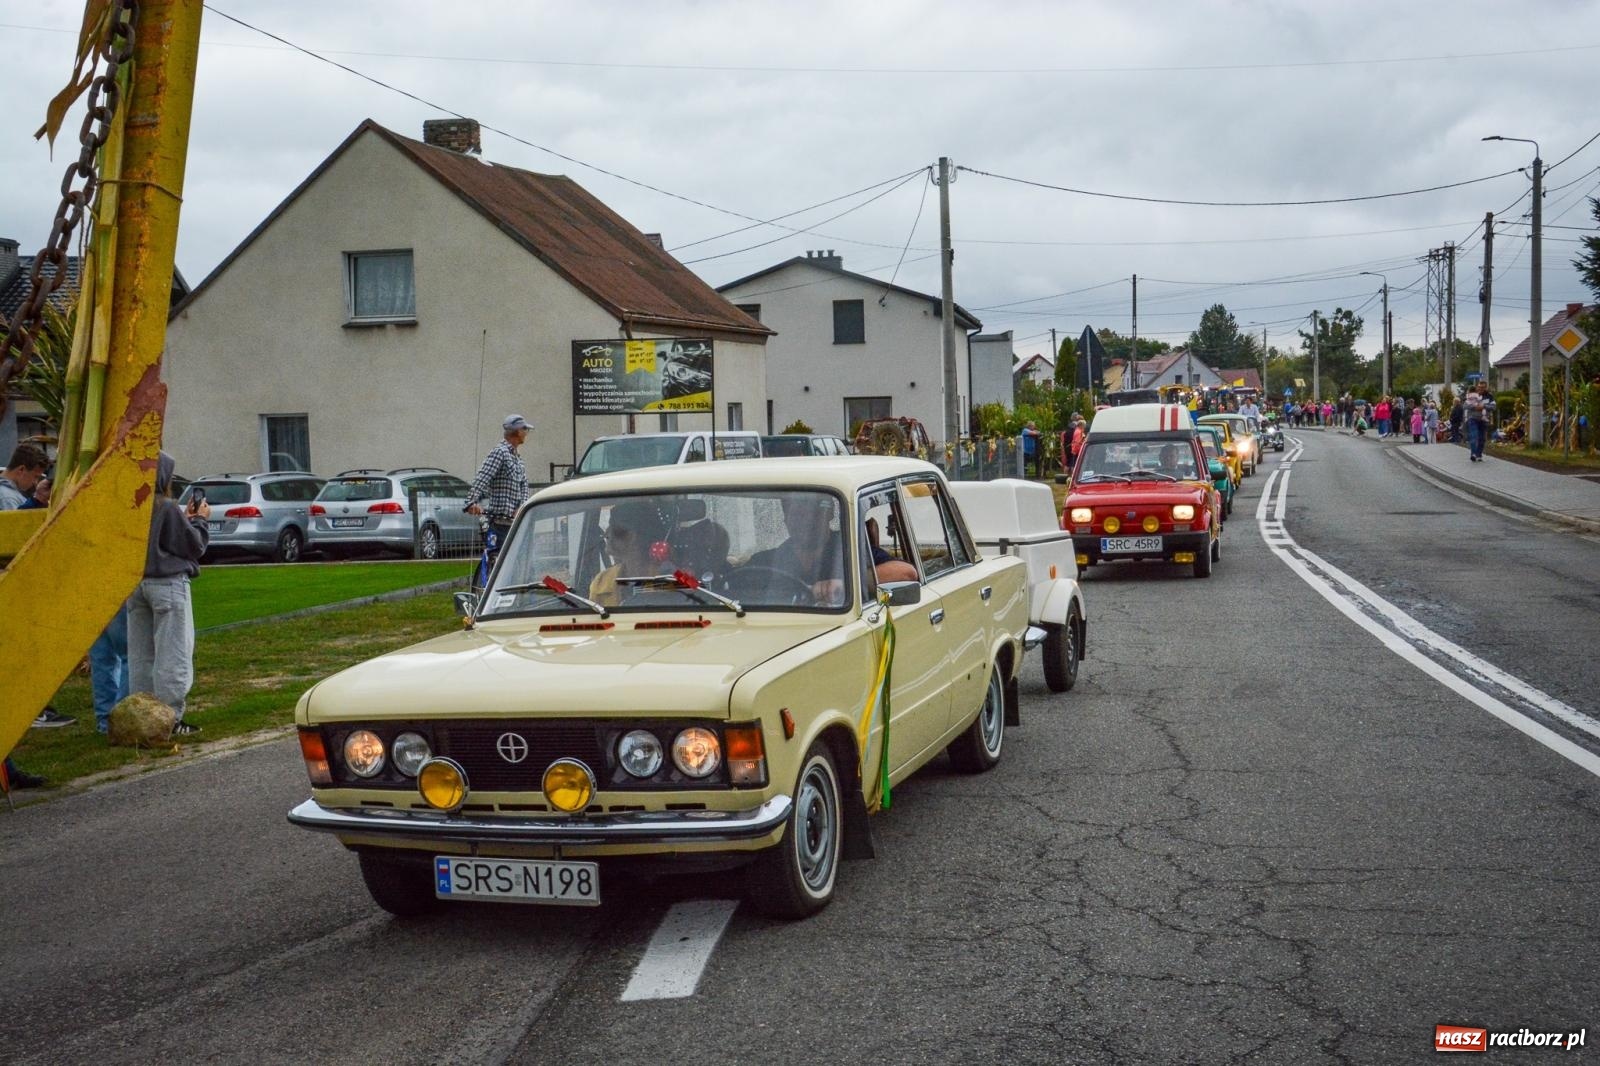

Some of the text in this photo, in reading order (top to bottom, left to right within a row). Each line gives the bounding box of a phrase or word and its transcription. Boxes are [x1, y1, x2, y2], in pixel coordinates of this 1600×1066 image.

[582, 358, 613, 368] AUTO
[1108, 539, 1160, 550] SRC 45R9
[439, 879, 450, 888] PL
[454, 863, 592, 896] SRS N198
